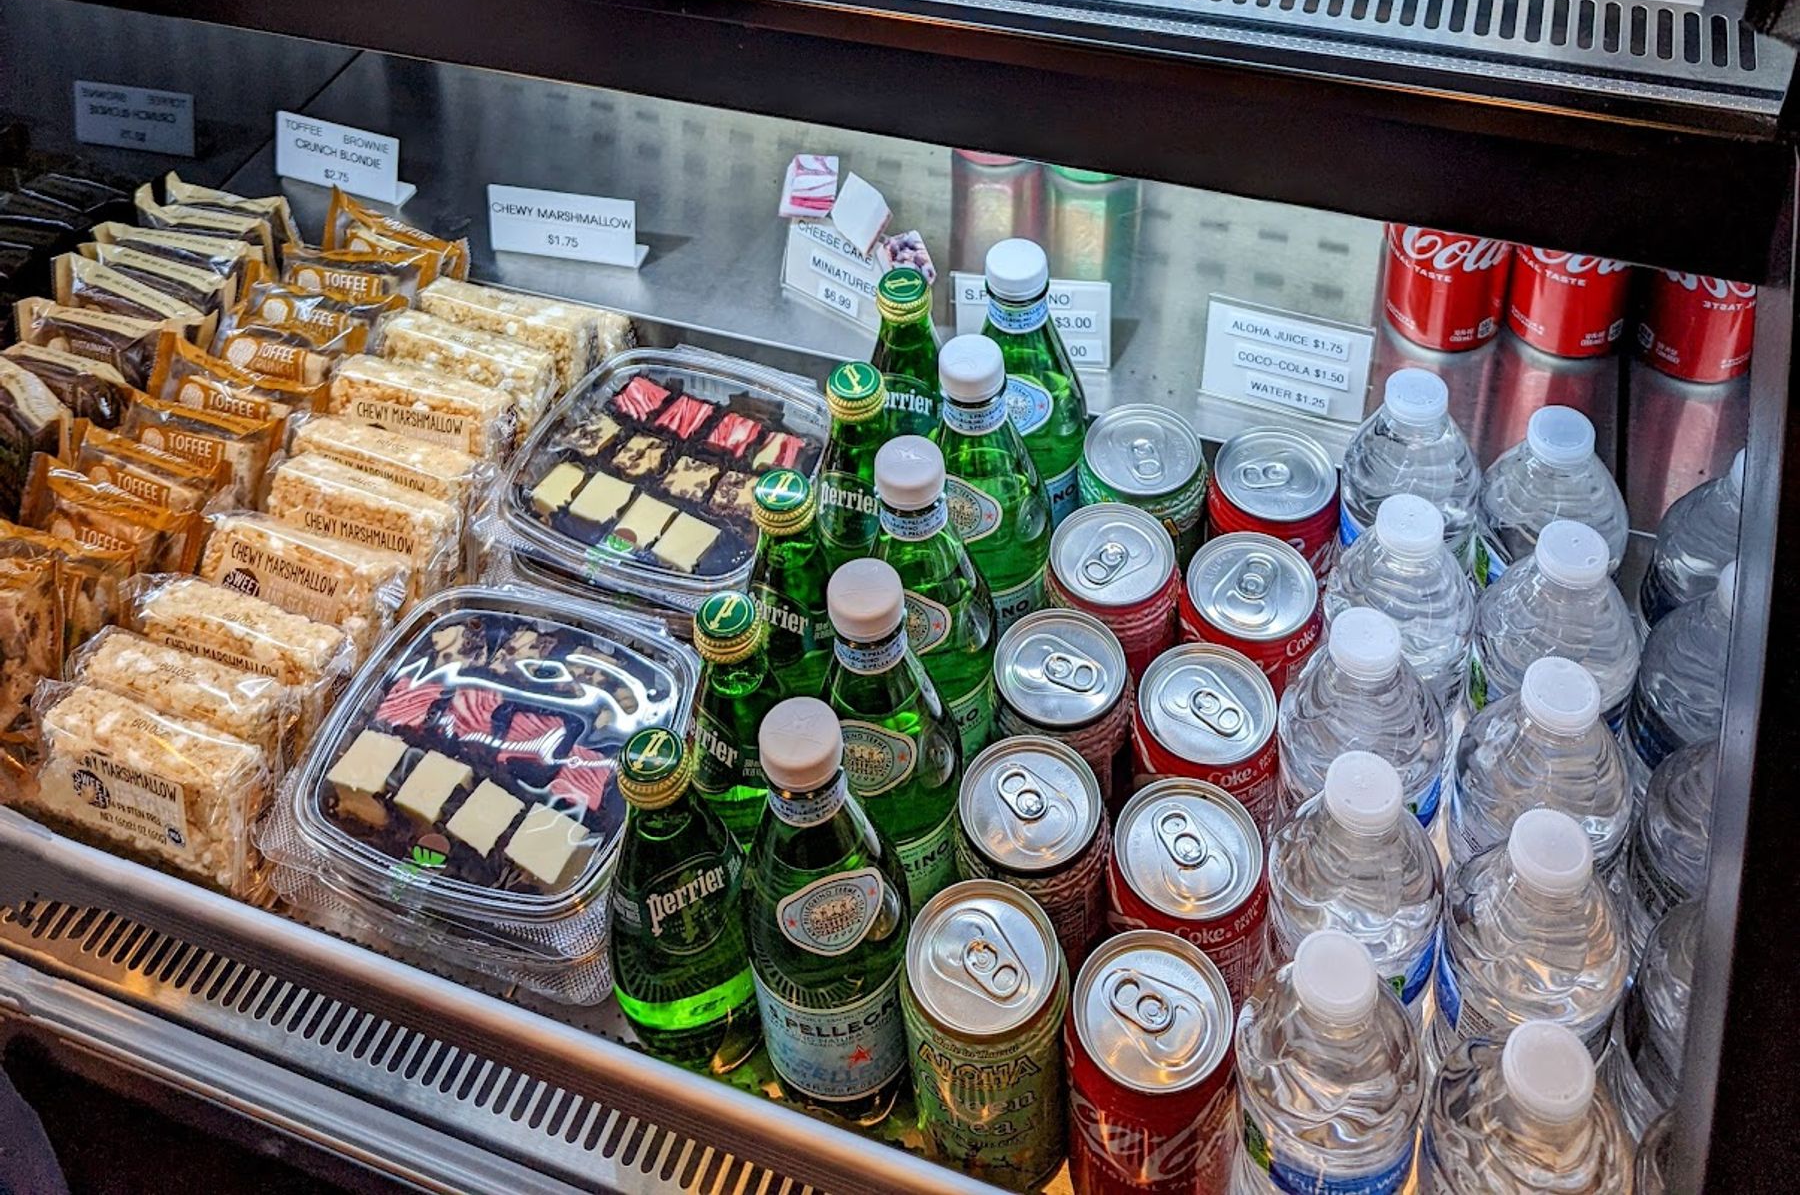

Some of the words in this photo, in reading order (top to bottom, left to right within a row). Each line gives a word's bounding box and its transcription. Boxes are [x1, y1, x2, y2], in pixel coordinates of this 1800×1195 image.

[285, 117, 324, 138] TOFFEE
[343, 133, 390, 154] BROWNIE
[295, 137, 338, 159] CRUNCH
[339, 148, 382, 169] BLONDIE
[323, 168, 350, 183] $2.75
[491, 201, 534, 217] CHEWY
[536, 207, 632, 230] MARSHMALLOW
[547, 233, 579, 248] $1.75
[797, 219, 841, 249] CHEESE
[323, 271, 369, 292] TOFFEE
[812, 255, 878, 298] MINIATURES
[1414, 266, 1453, 284] TASTE
[1545, 267, 1587, 287] TASTE
[1054, 317, 1092, 329] $3.00
[1232, 320, 1271, 338] ALOHA
[1274, 330, 1309, 347] JUICE
[1313, 339, 1344, 355] $1.75
[257, 341, 297, 363] TOFFEE
[1237, 350, 1310, 376] COCO-COLA
[1314, 367, 1345, 384] $1.50
[208, 389, 257, 416] TOFFEE
[884, 388, 933, 415] errier
[1250, 380, 1292, 400] WATER
[1295, 393, 1326, 409] $1.25
[356, 401, 389, 422] CHEWY
[391, 407, 464, 436] MARSHMALLOW
[168, 432, 214, 459] TOFFEE
[116, 472, 159, 501] TOFFEE
[304, 511, 337, 534] CHEWY
[339, 519, 416, 555] MARSHMALLOW
[231, 541, 264, 568] CHEWY
[264, 554, 339, 598] MARSHMALLOW
[750, 590, 810, 637] errier
[1286, 625, 1318, 657] Coke
[1207, 768, 1252, 787] Coke
[645, 865, 726, 938] Perrier
[1174, 925, 1226, 945] Coke
